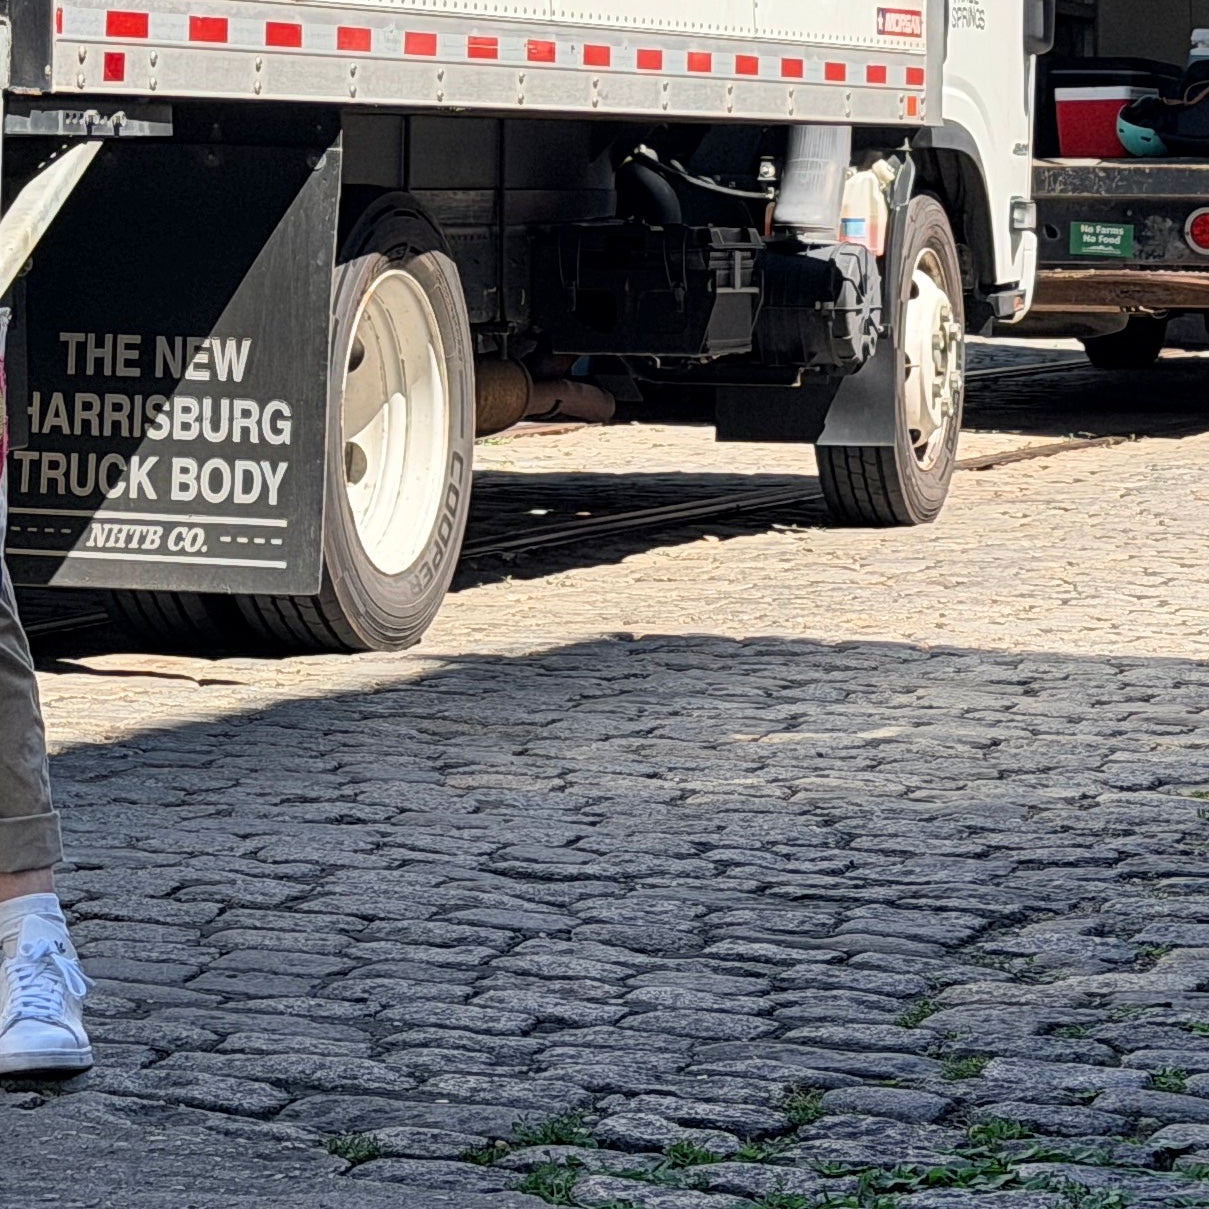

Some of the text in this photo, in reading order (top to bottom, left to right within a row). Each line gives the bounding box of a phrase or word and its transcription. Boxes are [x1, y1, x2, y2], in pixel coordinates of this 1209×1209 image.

[951, 6, 986, 31] SPRINGS
[1080, 224, 1125, 236] No Farms
[1082, 234, 1122, 245] No Food
[59, 332, 252, 383] THE NEW
[13, 450, 288, 505] TRUCK BODY
[86, 523, 208, 553] NHTB CO.
[409, 450, 464, 596] COOPER
